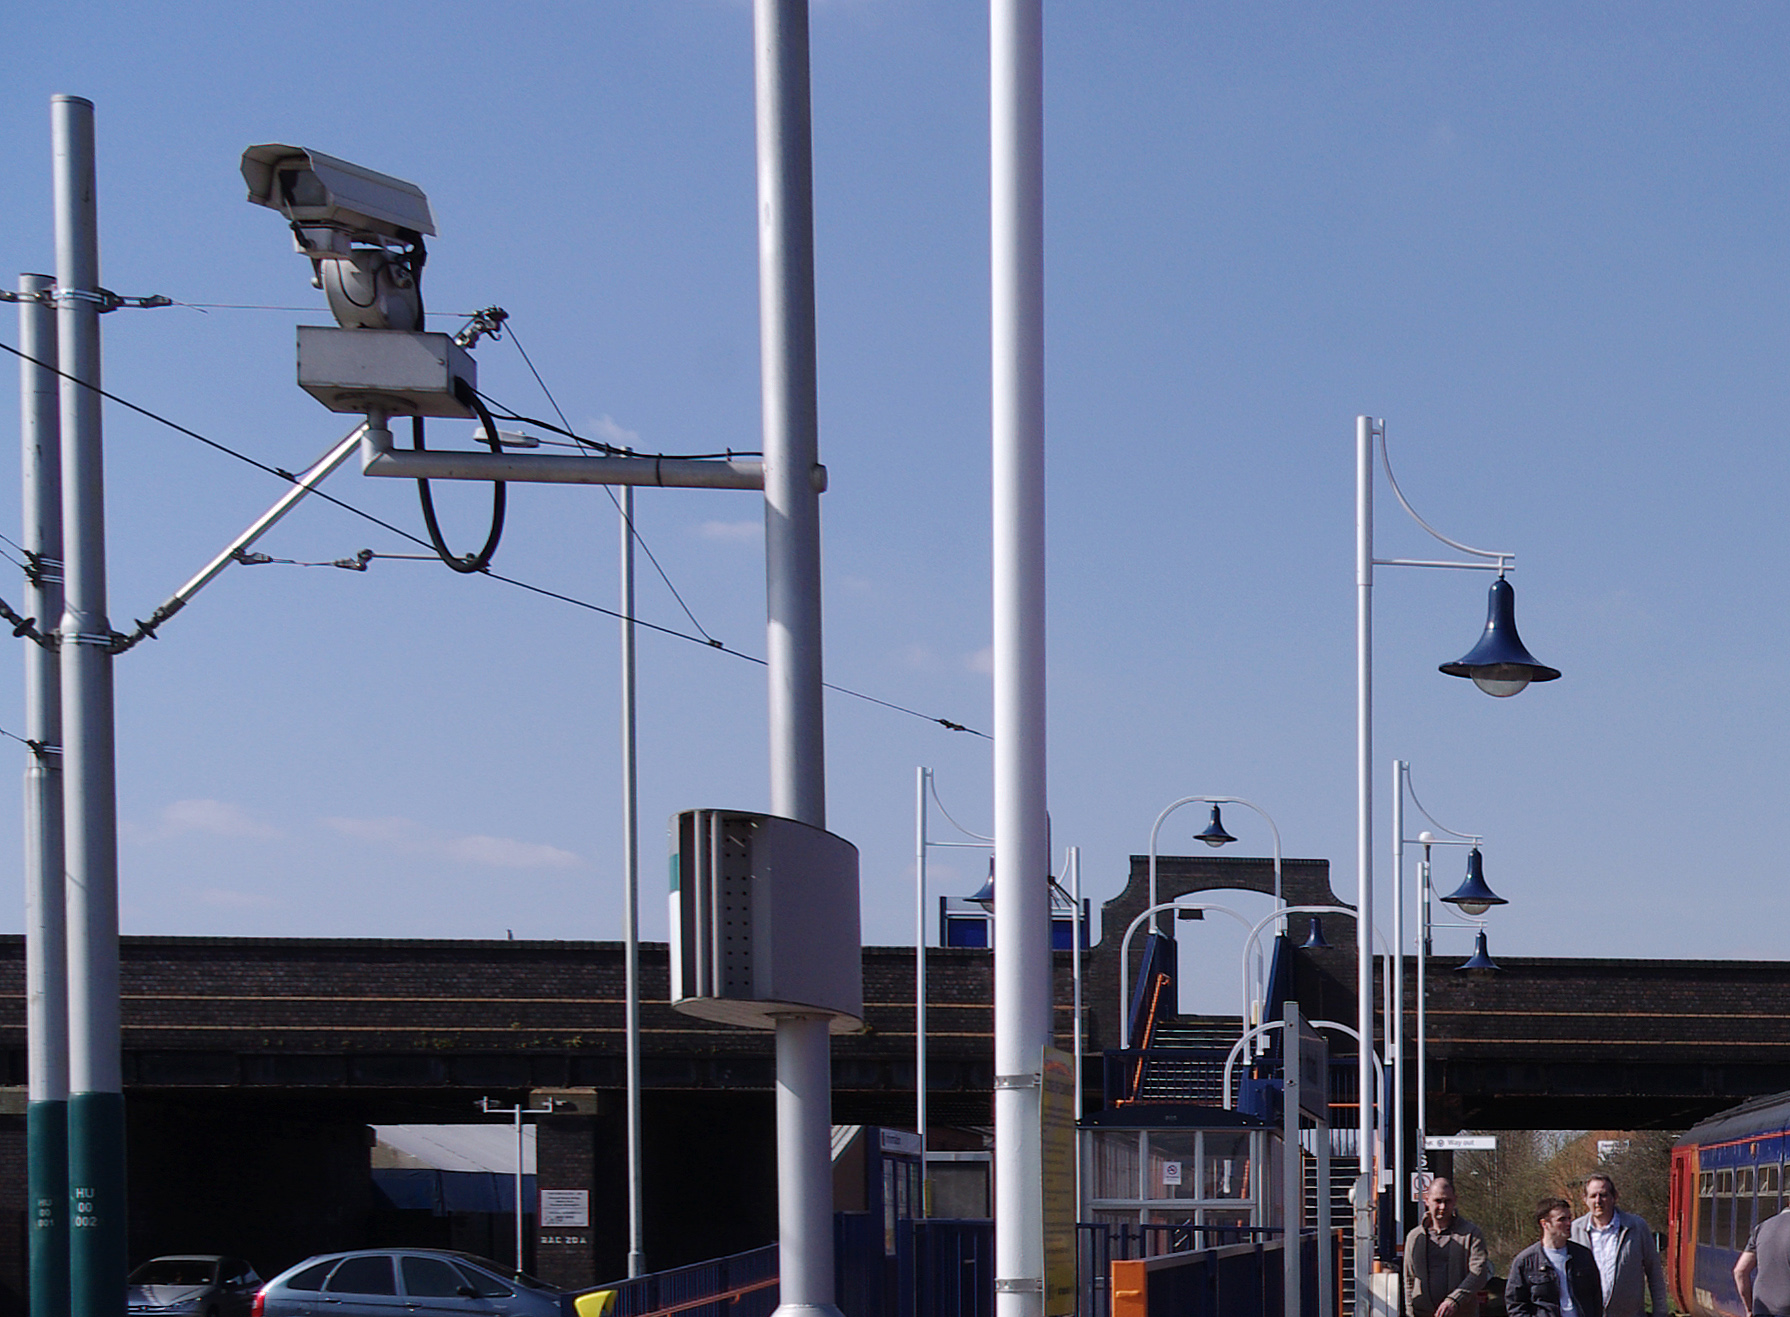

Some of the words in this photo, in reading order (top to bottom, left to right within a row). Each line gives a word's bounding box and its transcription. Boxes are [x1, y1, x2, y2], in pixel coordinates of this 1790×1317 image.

[76, 1188, 95, 1198] HU
[78, 1202, 93, 1212] 00
[75, 1216, 97, 1227] 002
